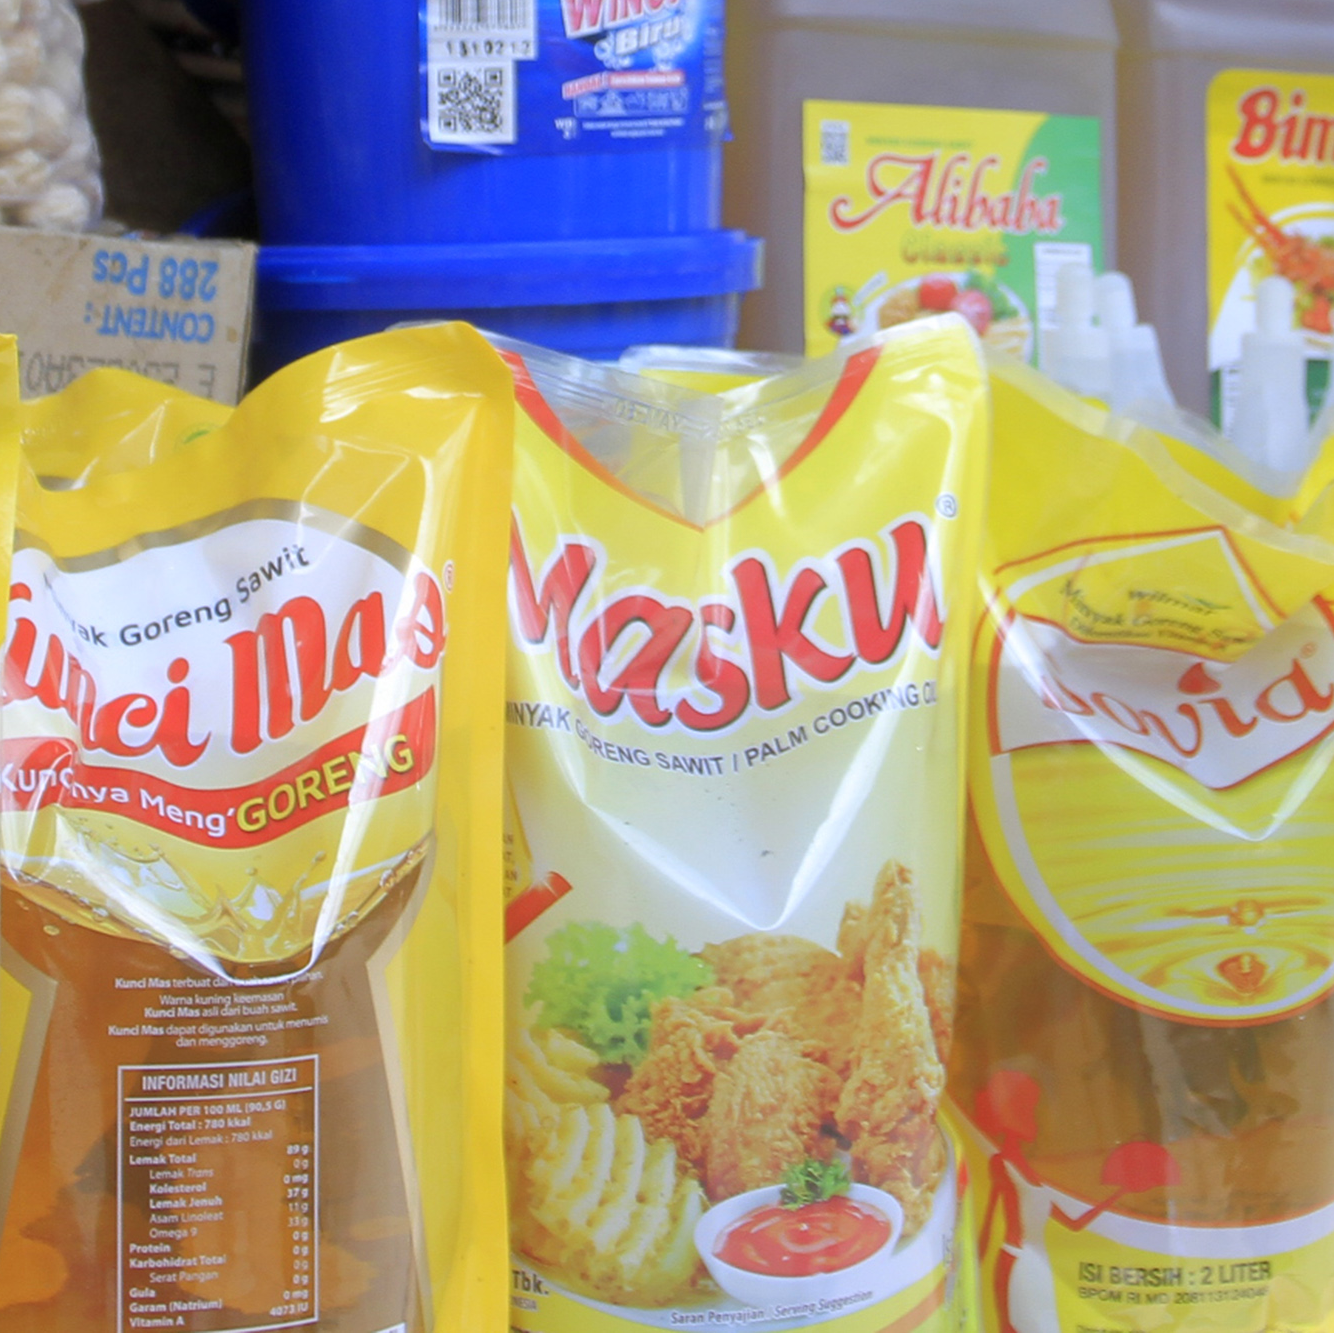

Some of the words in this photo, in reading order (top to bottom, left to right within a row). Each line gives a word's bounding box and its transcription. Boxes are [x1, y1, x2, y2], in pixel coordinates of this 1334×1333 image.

[828, 153, 1062, 232] Alibaba
[158, 257, 219, 303] 288
[97, 304, 215, 344] CONTENT
[119, 595, 233, 647] Goreng
[236, 544, 310, 604] Sawit
[223, 570, 447, 755] Mas
[655, 752, 725, 777] SAWIT
[746, 727, 809, 768] PALM
[812, 684, 919, 736] COOKING
[115, 978, 146, 989] Kunci
[148, 978, 171, 989] Mas
[172, 976, 211, 988] terbuat
[194, 993, 231, 1007] kuning
[233, 992, 285, 1004] keemasan
[144, 1007, 175, 1018] Kunci
[177, 1007, 200, 1017] Mas
[220, 1005, 241, 1016] dari
[242, 1004, 269, 1015] buah
[108, 1025, 139, 1036] Kunci
[141, 1025, 164, 1036] Mas
[166, 1025, 196, 1039] dapat
[197, 1022, 253, 1039] digunakan
[254, 1020, 285, 1032] untuk
[176, 1036, 197, 1048] dan
[142, 1074, 224, 1091] INFORMASI
[228, 1071, 266, 1088] NILAI
[270, 1068, 298, 1084] GIZI
[129, 1107, 177, 1118] JUMLAH
[179, 1105, 201, 1116] PER
[204, 1104, 224, 1115] 100
[226, 1103, 243, 1114] ML
[129, 1121, 166, 1133] Energi
[167, 1119, 196, 1131] Total
[204, 1118, 226, 1129] 780
[227, 1116, 252, 1128] kkal
[129, 1136, 164, 1149] Energi
[165, 1135, 187, 1146] dari
[189, 1133, 223, 1144] Lemak
[231, 1131, 250, 1142] 780
[251, 1129, 273, 1140] kkal
[129, 1155, 166, 1166] Lemak
[169, 1153, 197, 1164] Total
[149, 1169, 184, 1180] Lemak
[187, 1167, 214, 1178] Trans
[149, 1182, 207, 1195] Kolesterol
[287, 1188, 300, 1199] 37
[149, 1198, 186, 1209] Lemak
[189, 1196, 222, 1207] Jenuh
[149, 1213, 179, 1224] Asam
[181, 1211, 224, 1222] Linoleat
[149, 1228, 188, 1240] Omega
[129, 1243, 171, 1254] Protein
[129, 1257, 198, 1269] Karbohidrat
[199, 1255, 227, 1266] Total
[149, 1272, 177, 1283] Serat
[179, 1271, 219, 1284] Pangan
[1079, 1261, 1103, 1283] ISI
[1109, 1266, 1183, 1287] BERSIH
[1201, 1266, 1213, 1285] 2
[1219, 1260, 1272, 1284] LITER
[512, 1268, 550, 1296] Tbk.
[129, 1287, 156, 1298] Gula
[129, 1303, 167, 1314] Garam
[169, 1300, 223, 1313] (Natrium)
[774, 1302, 816, 1318] Serving
[817, 1289, 874, 1312] Suggestion
[129, 1317, 174, 1328] Vitamin
[175, 1316, 185, 1326] A
[671, 1312, 704, 1325] Saran
[708, 1310, 765, 1325] Penyajian
